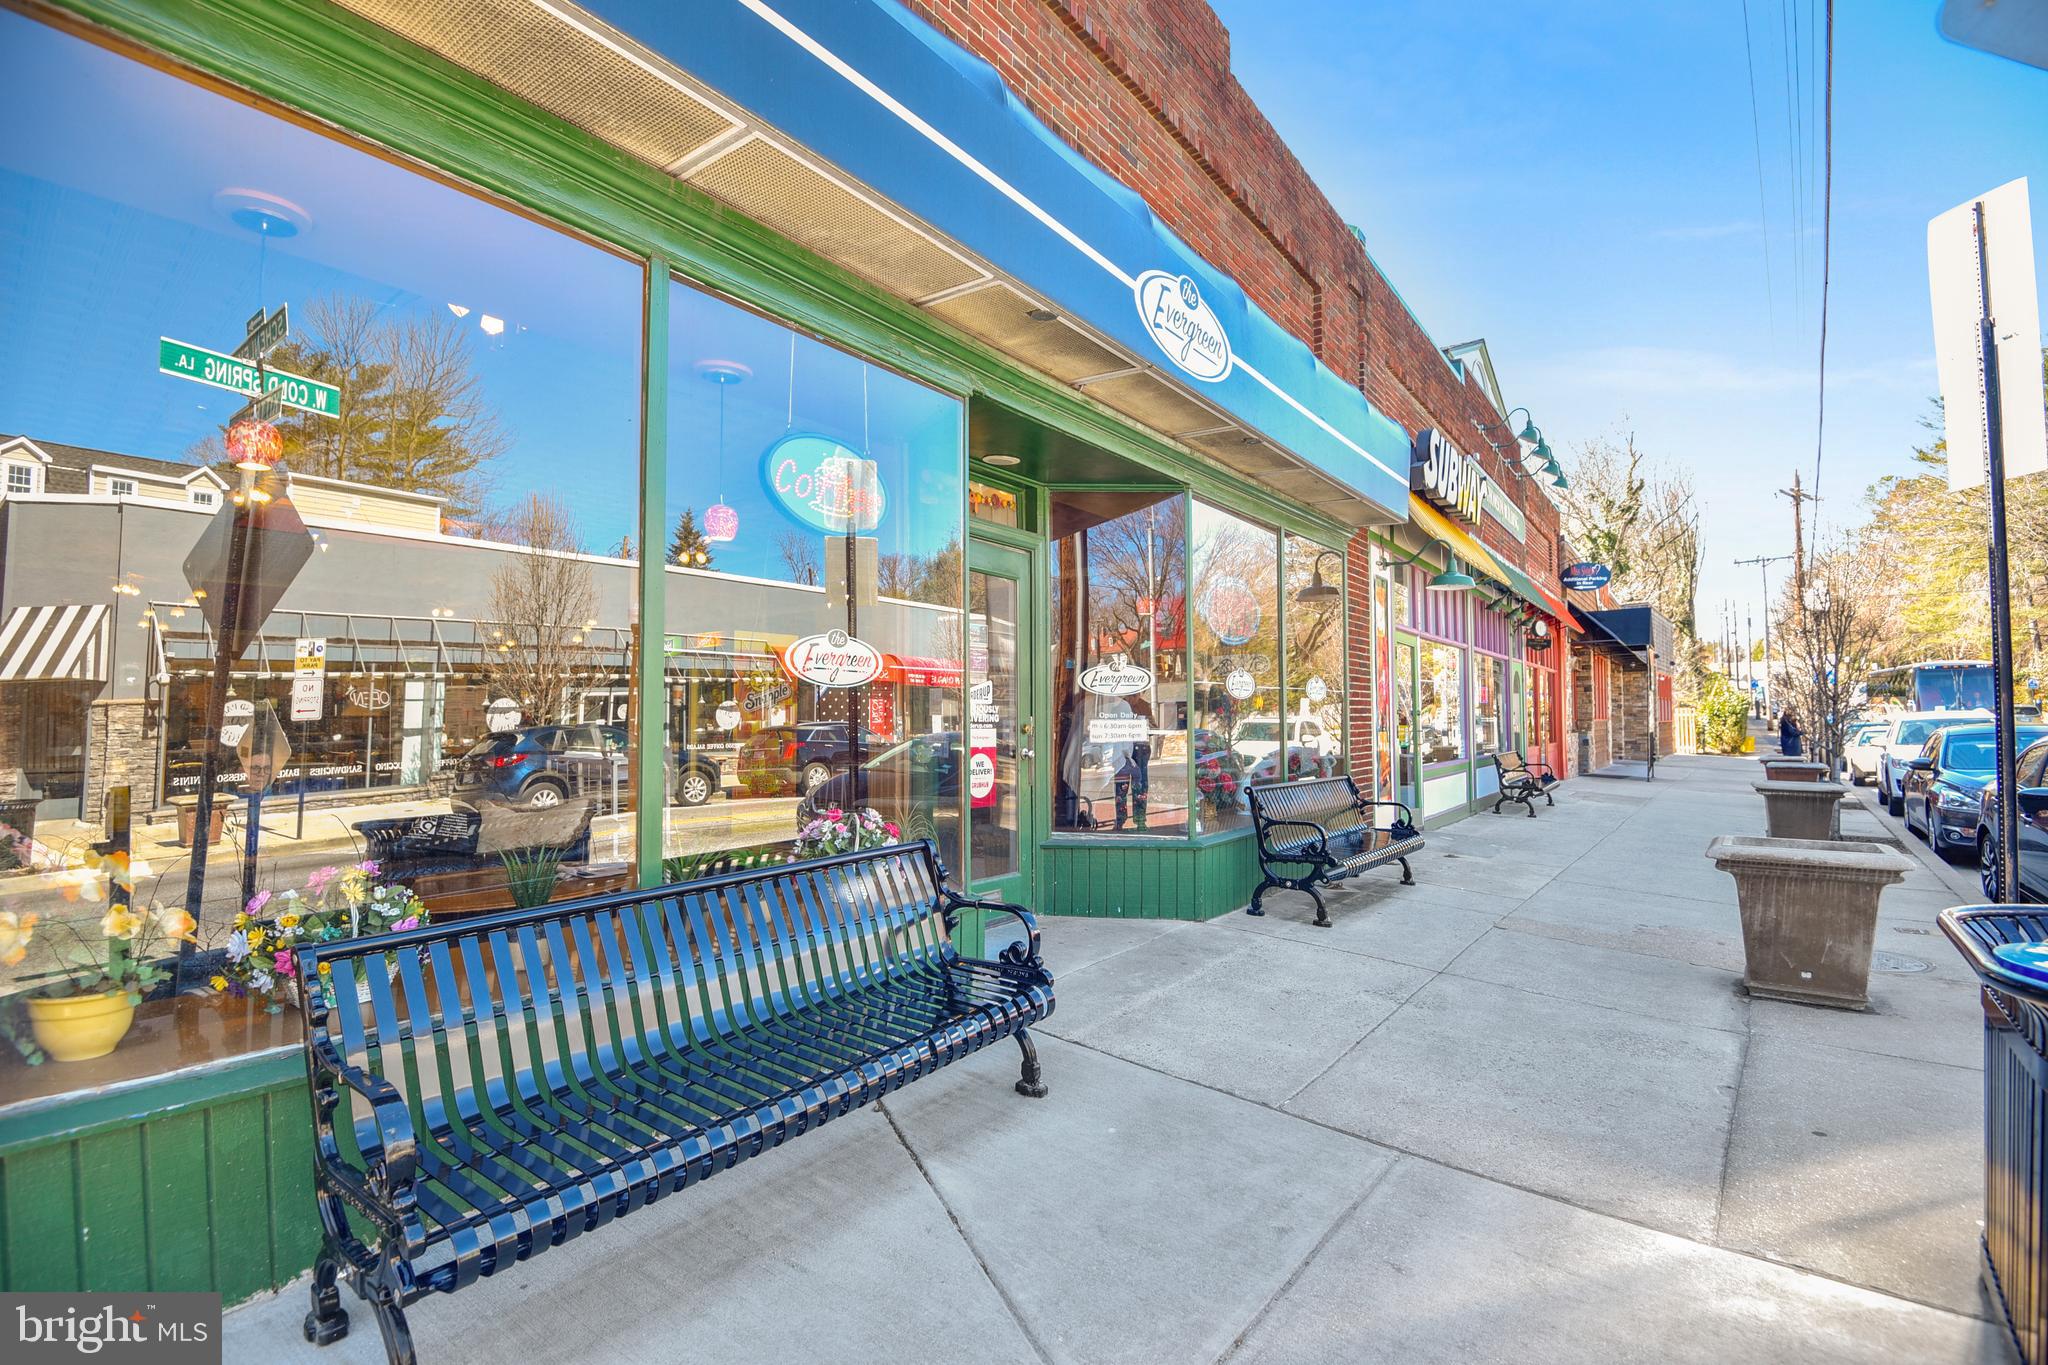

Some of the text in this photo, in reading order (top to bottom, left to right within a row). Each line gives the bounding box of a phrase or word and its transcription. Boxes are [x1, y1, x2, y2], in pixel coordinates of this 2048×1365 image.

[1182, 282, 1197, 306] the
[1153, 284, 1222, 362] Evergreen
[1423, 427, 1488, 526] SUBWAY
[831, 632, 846, 645] the
[802, 643, 872, 682] Evergreen
[1090, 670, 1146, 693] Evergreen
[1120, 711, 1138, 719] Daily
